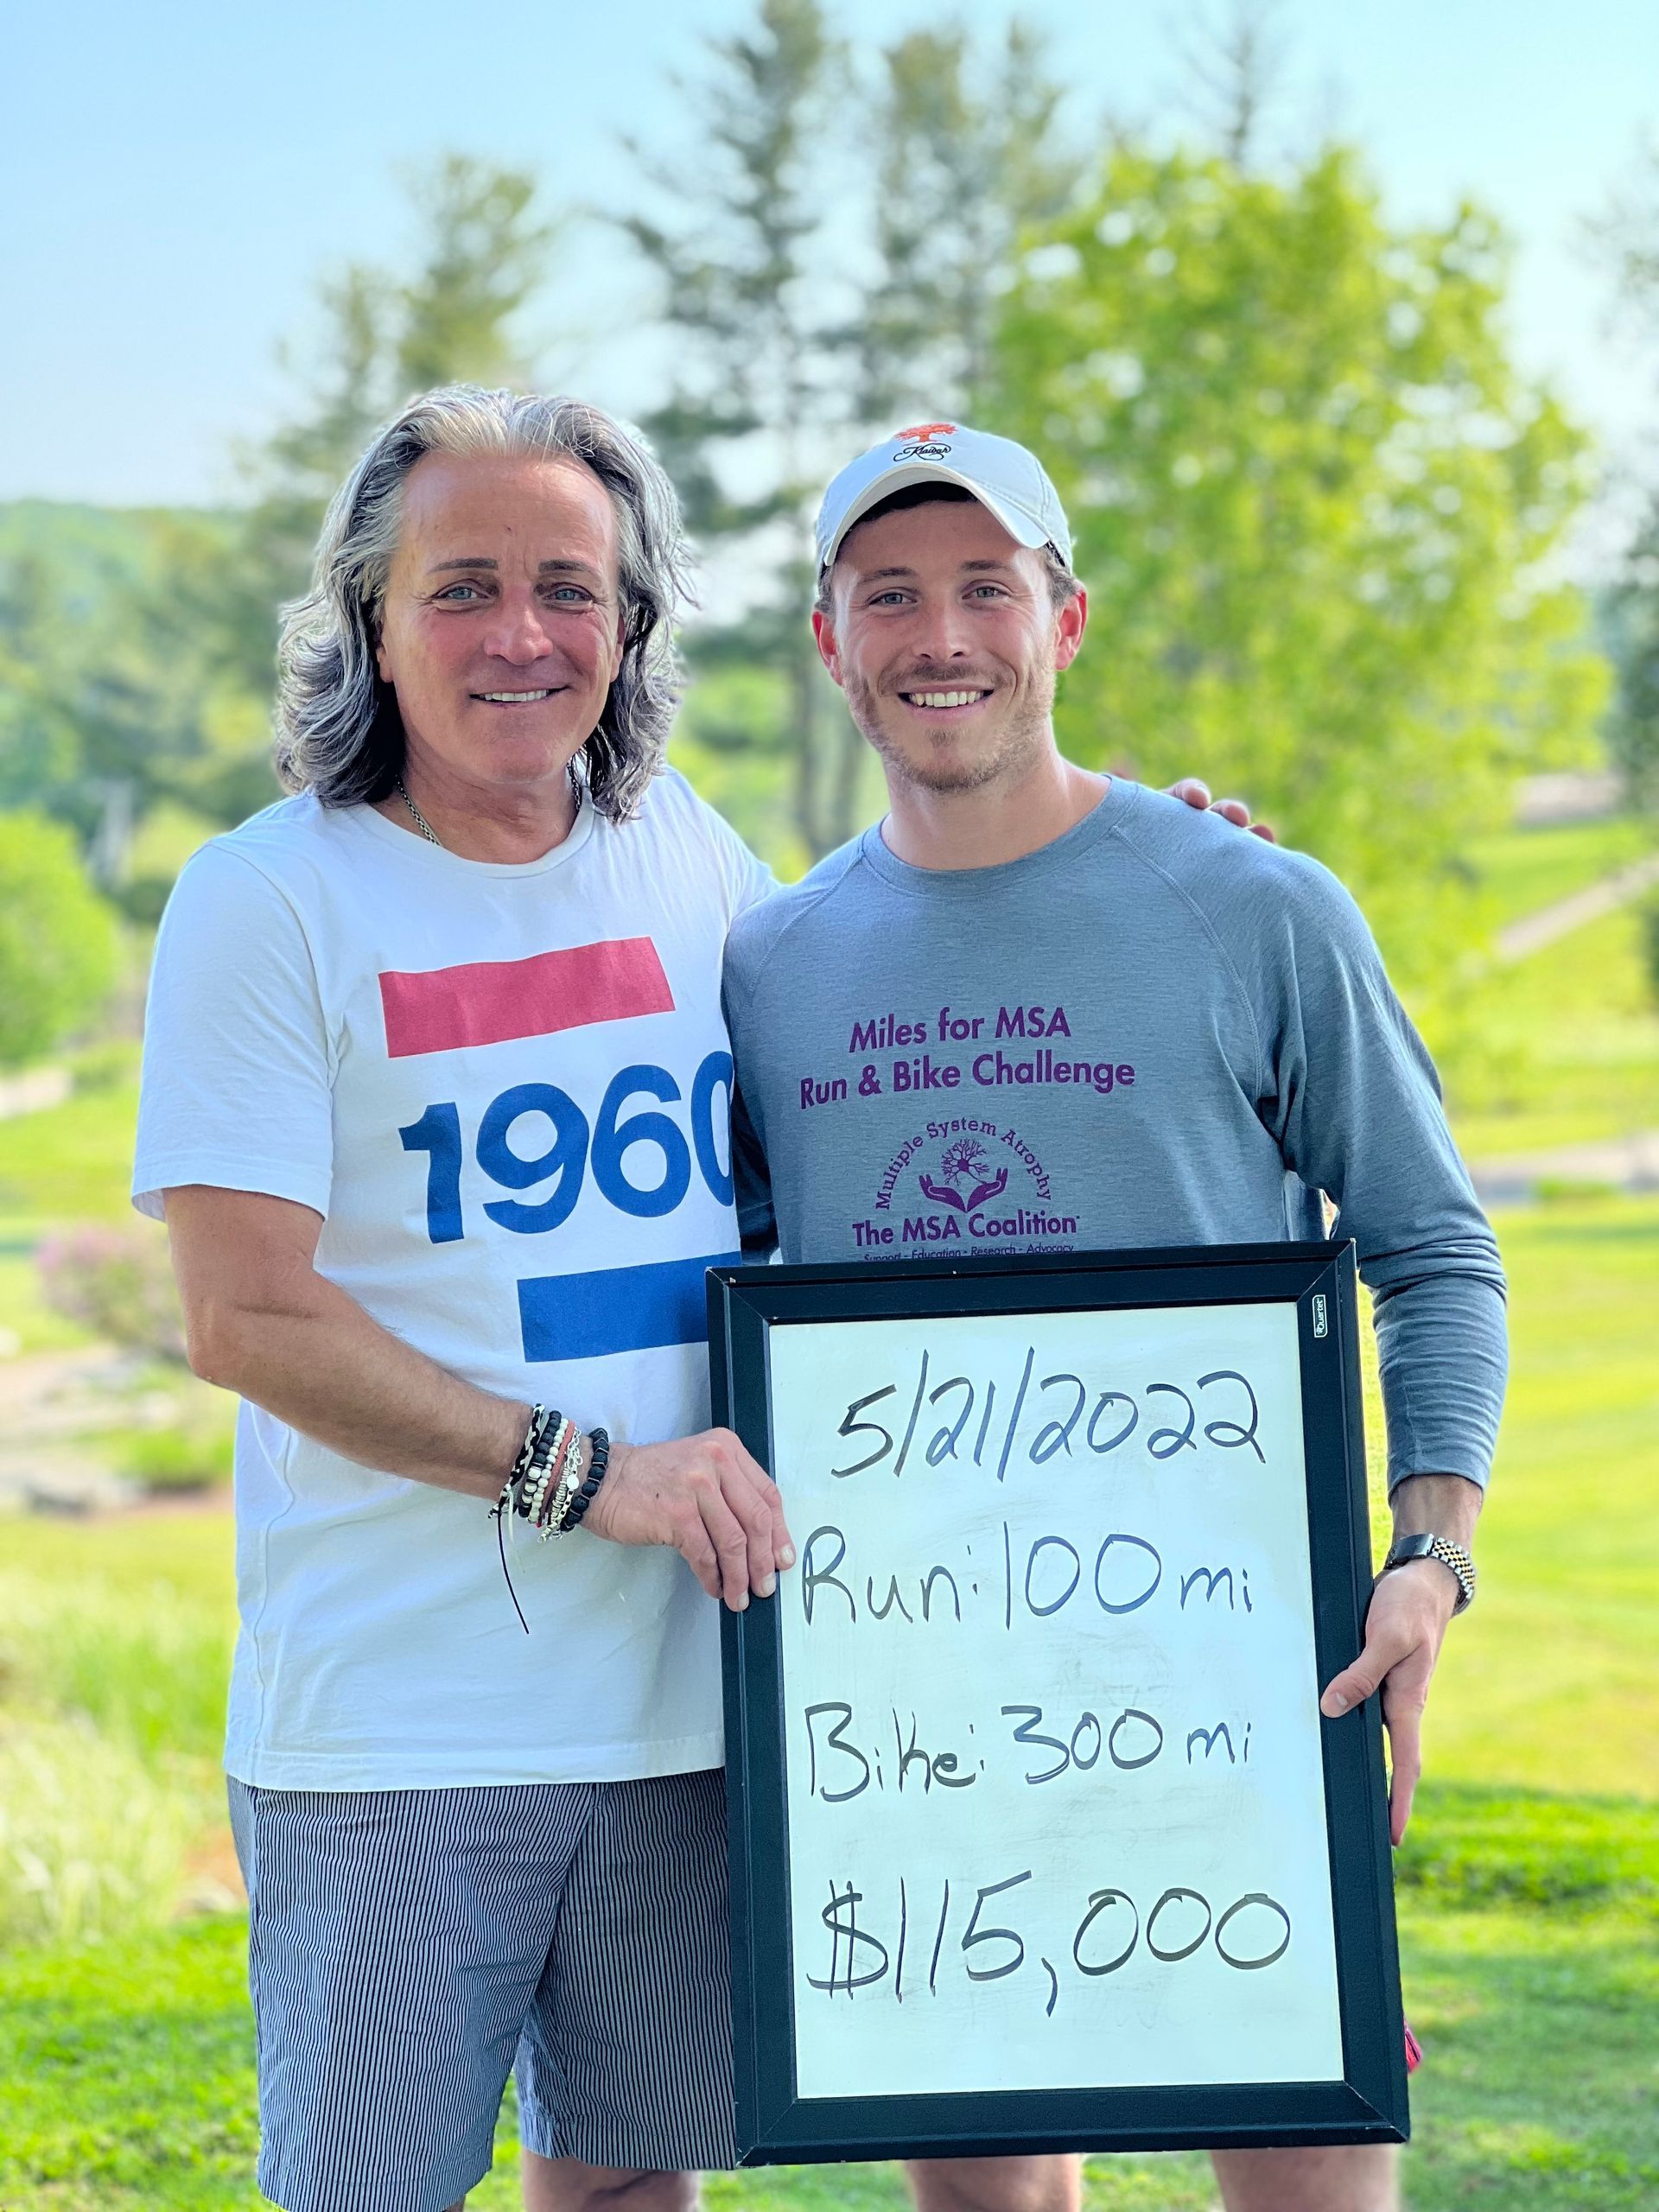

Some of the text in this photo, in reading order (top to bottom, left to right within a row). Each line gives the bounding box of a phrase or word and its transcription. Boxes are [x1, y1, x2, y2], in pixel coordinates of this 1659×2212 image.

[849, 1007, 1071, 1053] Miles for MSA
[800, 1049, 1135, 1109] Run & Bike Challenge
[398, 1051, 734, 1244] 1960
[875, 1117, 1051, 1210] Multiple System Atrophy
[852, 1209, 1077, 1246] The MSA Coalition
[971, 1244, 1016, 1256] Research
[831, 1346, 1266, 1482] 5/21/2022
[803, 1521, 1253, 1630] Run: 100 mi
[804, 1701, 1251, 1802] Bike: 300 mi
[806, 1870, 1291, 2017] $115,000
